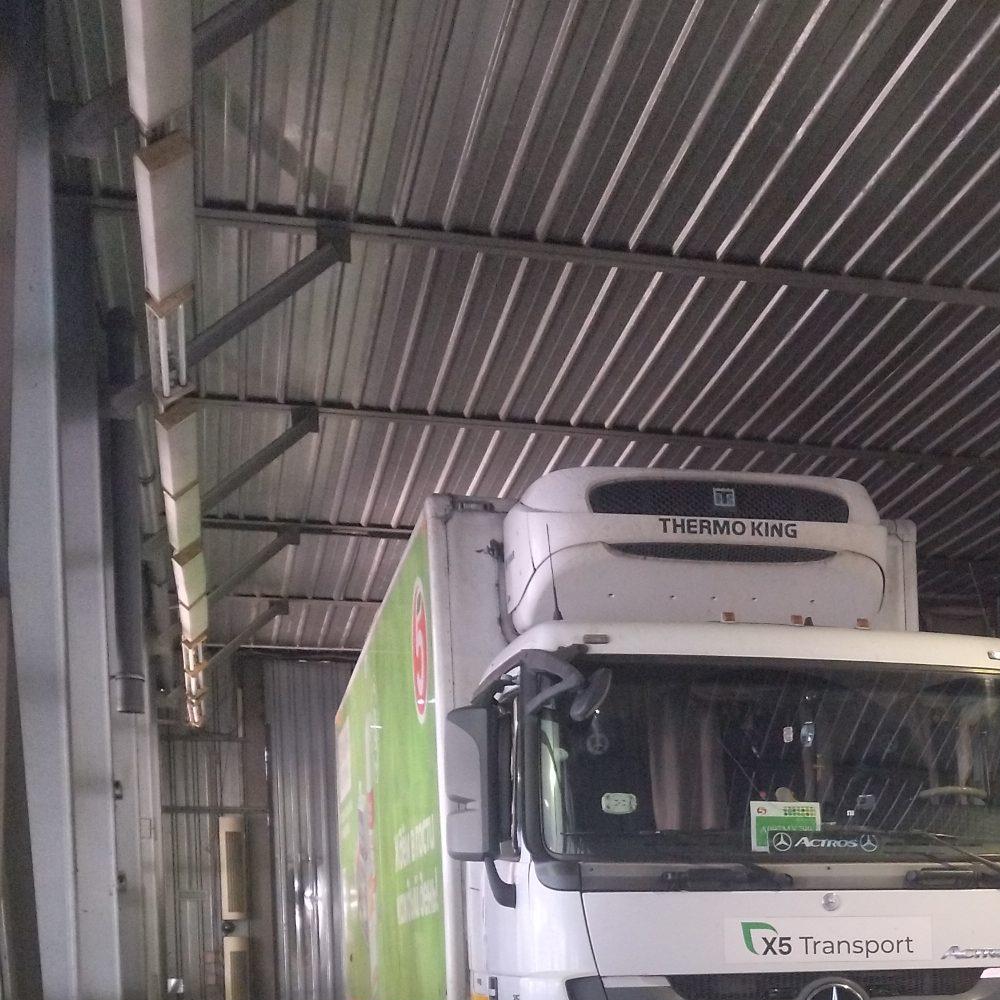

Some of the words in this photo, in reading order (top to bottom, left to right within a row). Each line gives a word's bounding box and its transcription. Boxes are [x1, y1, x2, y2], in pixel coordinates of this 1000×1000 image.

[659, 518, 746, 535] THERMO
[751, 521, 797, 538] KING
[762, 937, 792, 955] X5
[799, 936, 914, 958] Transport
